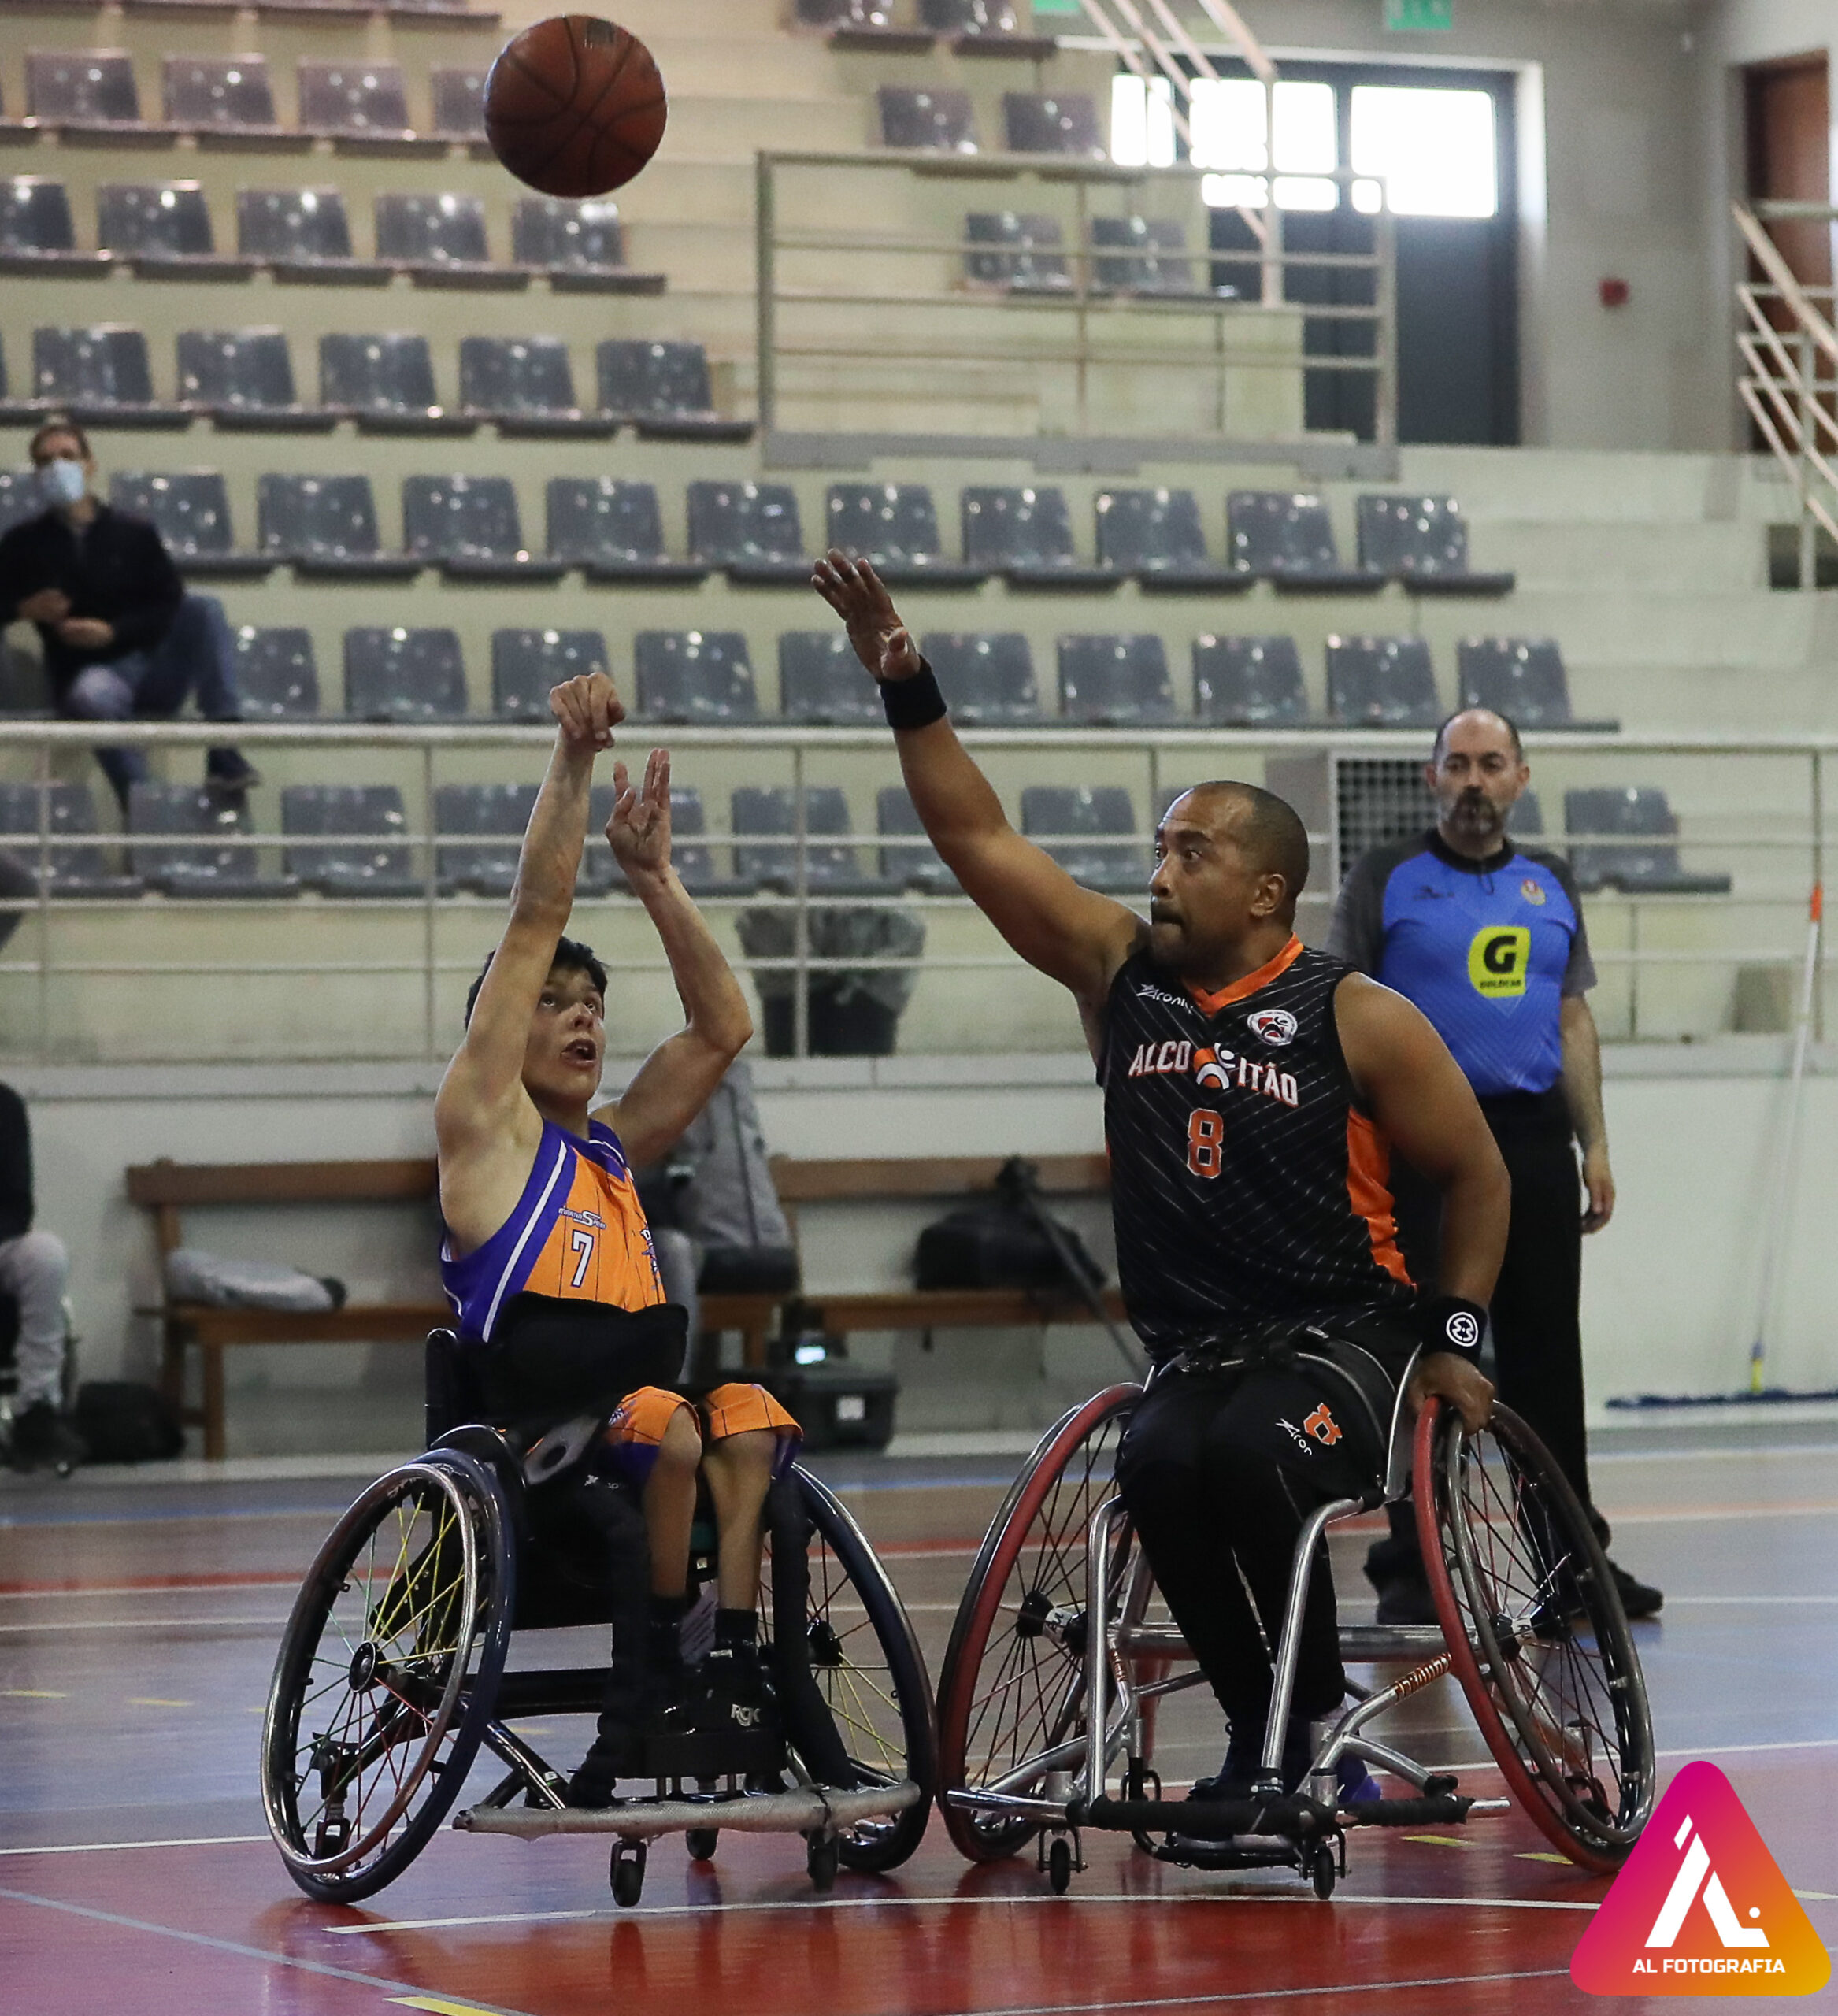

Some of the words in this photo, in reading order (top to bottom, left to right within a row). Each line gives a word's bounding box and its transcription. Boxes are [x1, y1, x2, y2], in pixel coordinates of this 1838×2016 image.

[1484, 936, 1517, 973] G
[1187, 1108, 1224, 1179] 8
[571, 1229, 594, 1288] 7
